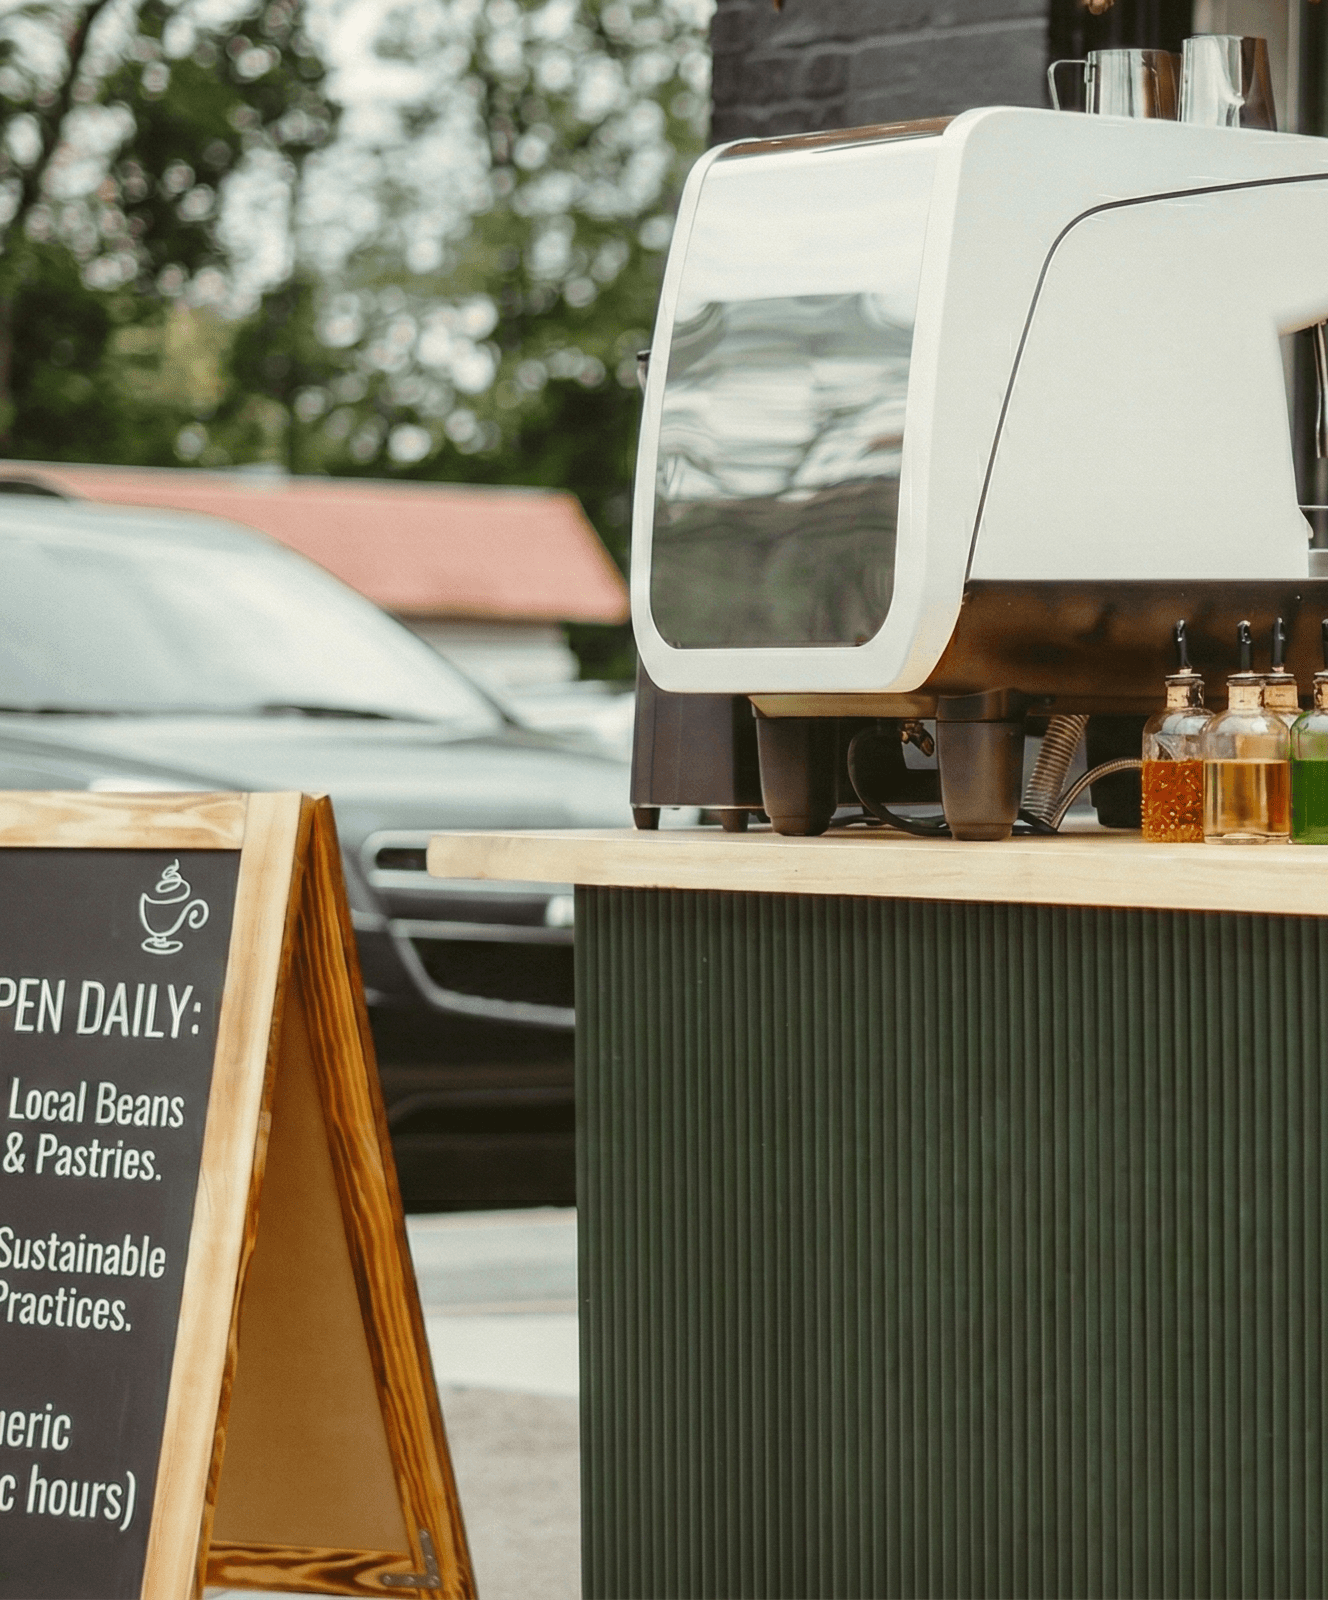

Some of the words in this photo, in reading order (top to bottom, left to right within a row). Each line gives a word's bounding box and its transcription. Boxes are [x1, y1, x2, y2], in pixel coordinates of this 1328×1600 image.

[76, 980, 202, 1039] DAILY:
[8, 1076, 88, 1124] Local
[94, 1081, 185, 1128] Beans
[2, 1131, 26, 1174] &
[35, 1133, 162, 1181] Pastries.
[0, 1226, 166, 1279] Sustainable
[26, 1463, 136, 1532] hours)
